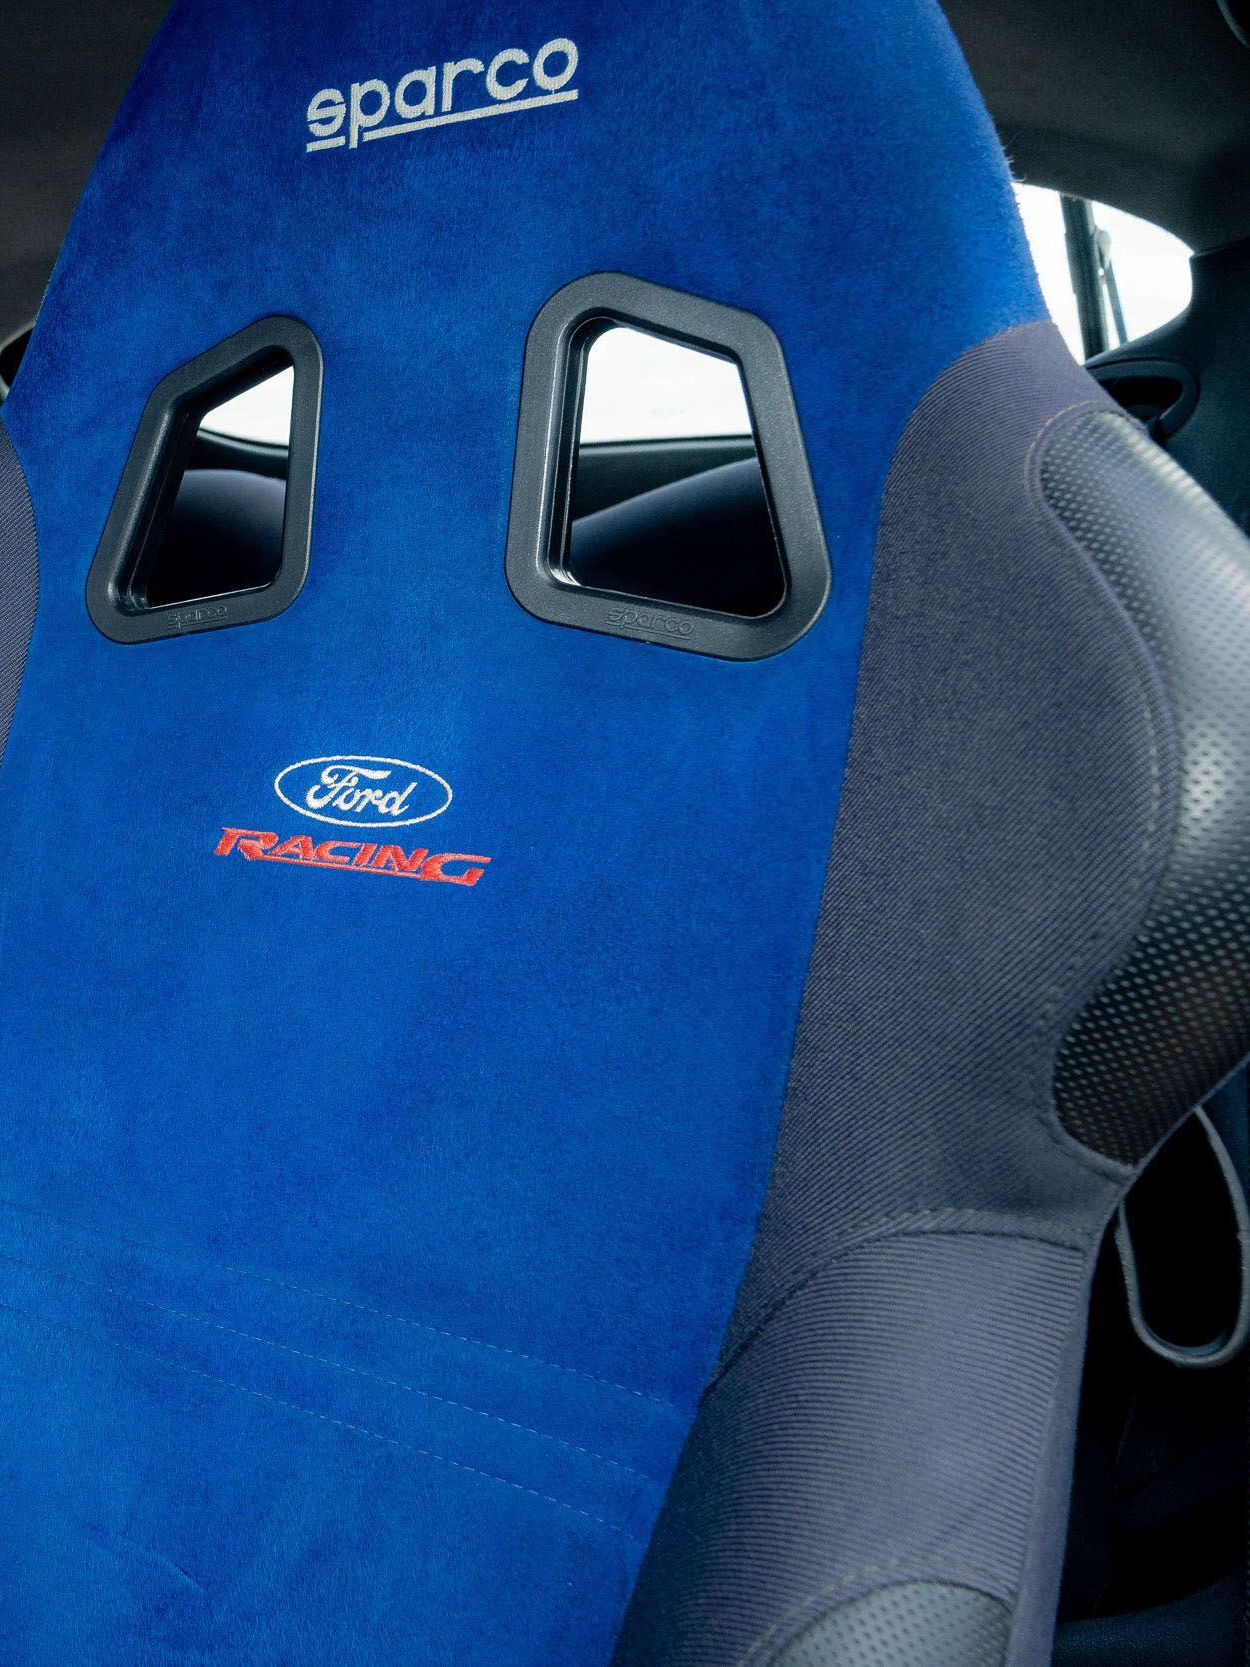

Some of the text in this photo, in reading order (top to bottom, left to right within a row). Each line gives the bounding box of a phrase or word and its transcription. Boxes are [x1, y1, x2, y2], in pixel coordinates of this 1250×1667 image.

[306, 38, 579, 151] sparco
[605, 606, 695, 640] sparco
[305, 764, 418, 816] Ford
[213, 827, 492, 887] RACING
